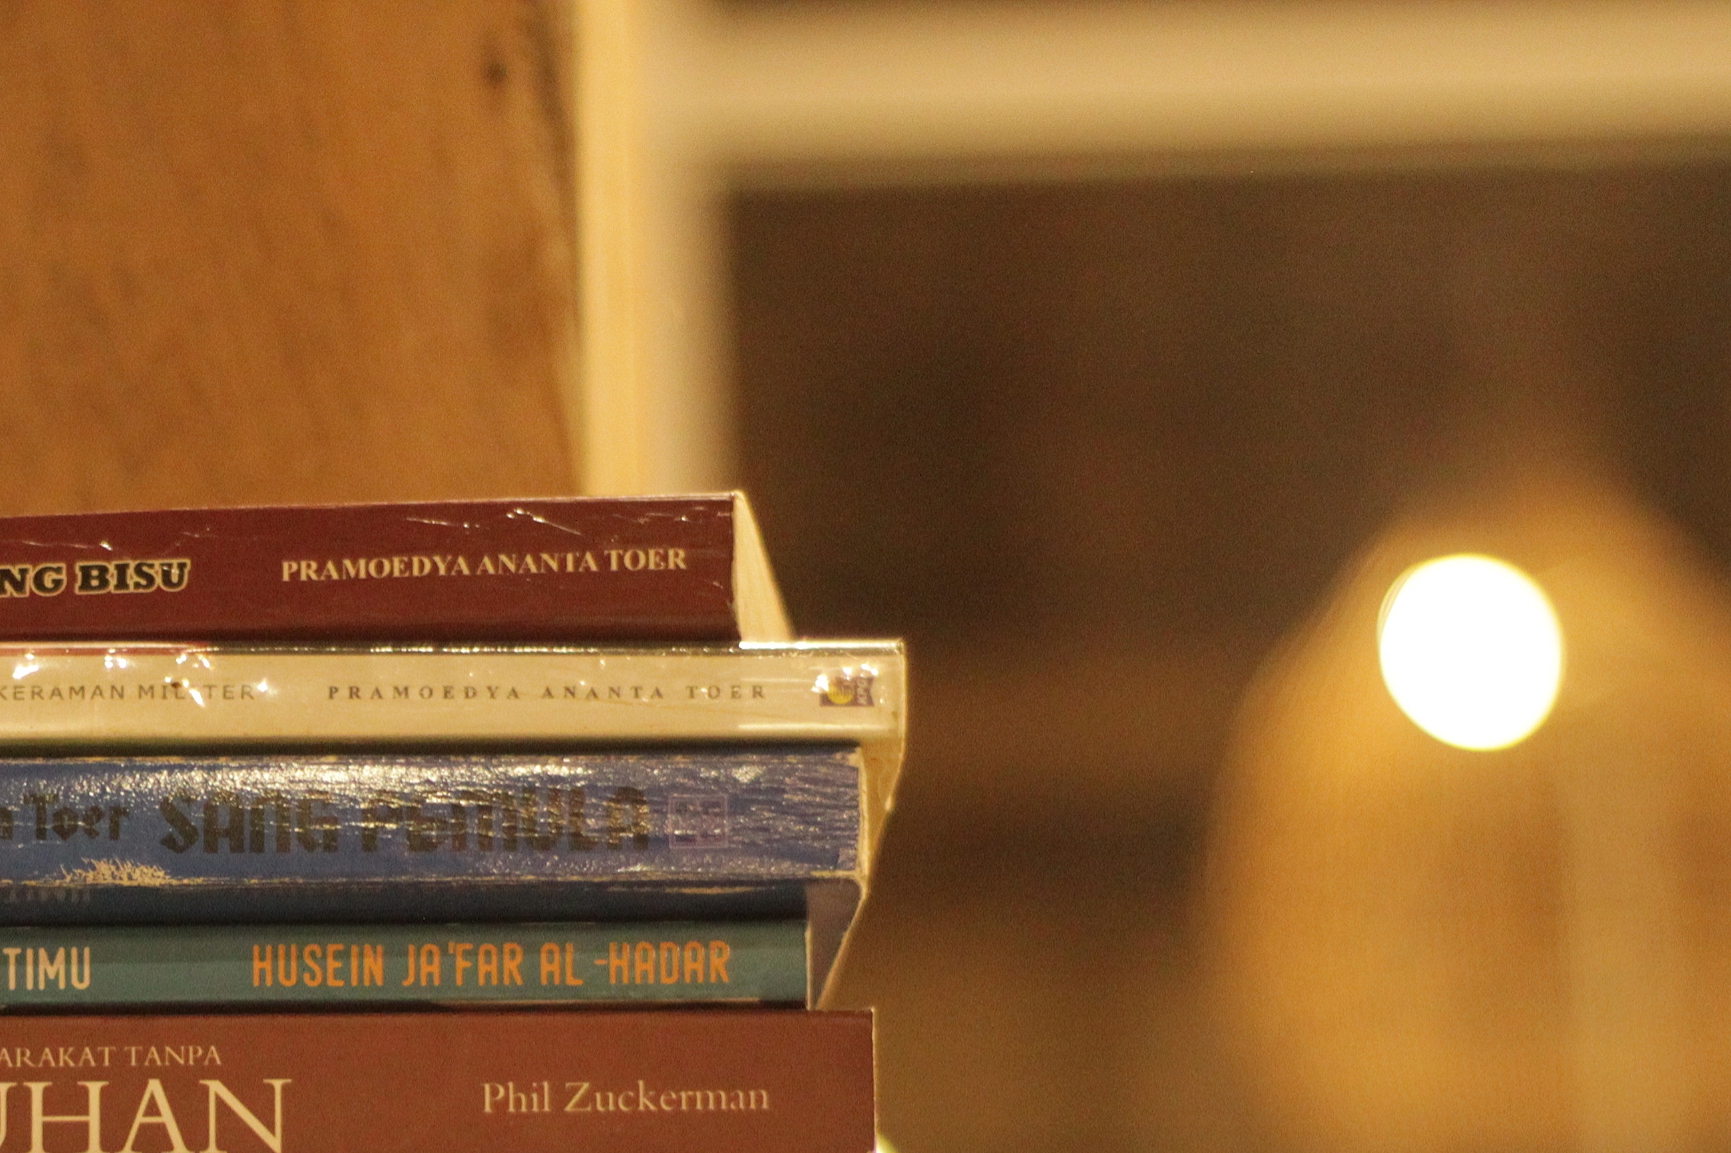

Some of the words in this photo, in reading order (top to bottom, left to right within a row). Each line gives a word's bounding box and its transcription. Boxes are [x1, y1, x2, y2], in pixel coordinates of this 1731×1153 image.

[76, 559, 191, 593] BISU
[281, 553, 471, 582] PRAMOEDYA
[475, 551, 599, 575] ANANTA
[605, 547, 688, 572] TOER
[138, 683, 255, 700] MILTER
[328, 685, 521, 701] PRAMOEDYA
[541, 685, 664, 700] ANANTA
[686, 684, 767, 700] TOER
[22, 794, 129, 841] Toer
[159, 790, 339, 853] SANG
[252, 944, 383, 987] HUSEIN
[402, 943, 523, 986] JA'FAR
[540, 942, 584, 985] AL
[124, 1044, 222, 1066] TANPA
[482, 1081, 551, 1113] Phil
[564, 1080, 770, 1111] Zuckerman
